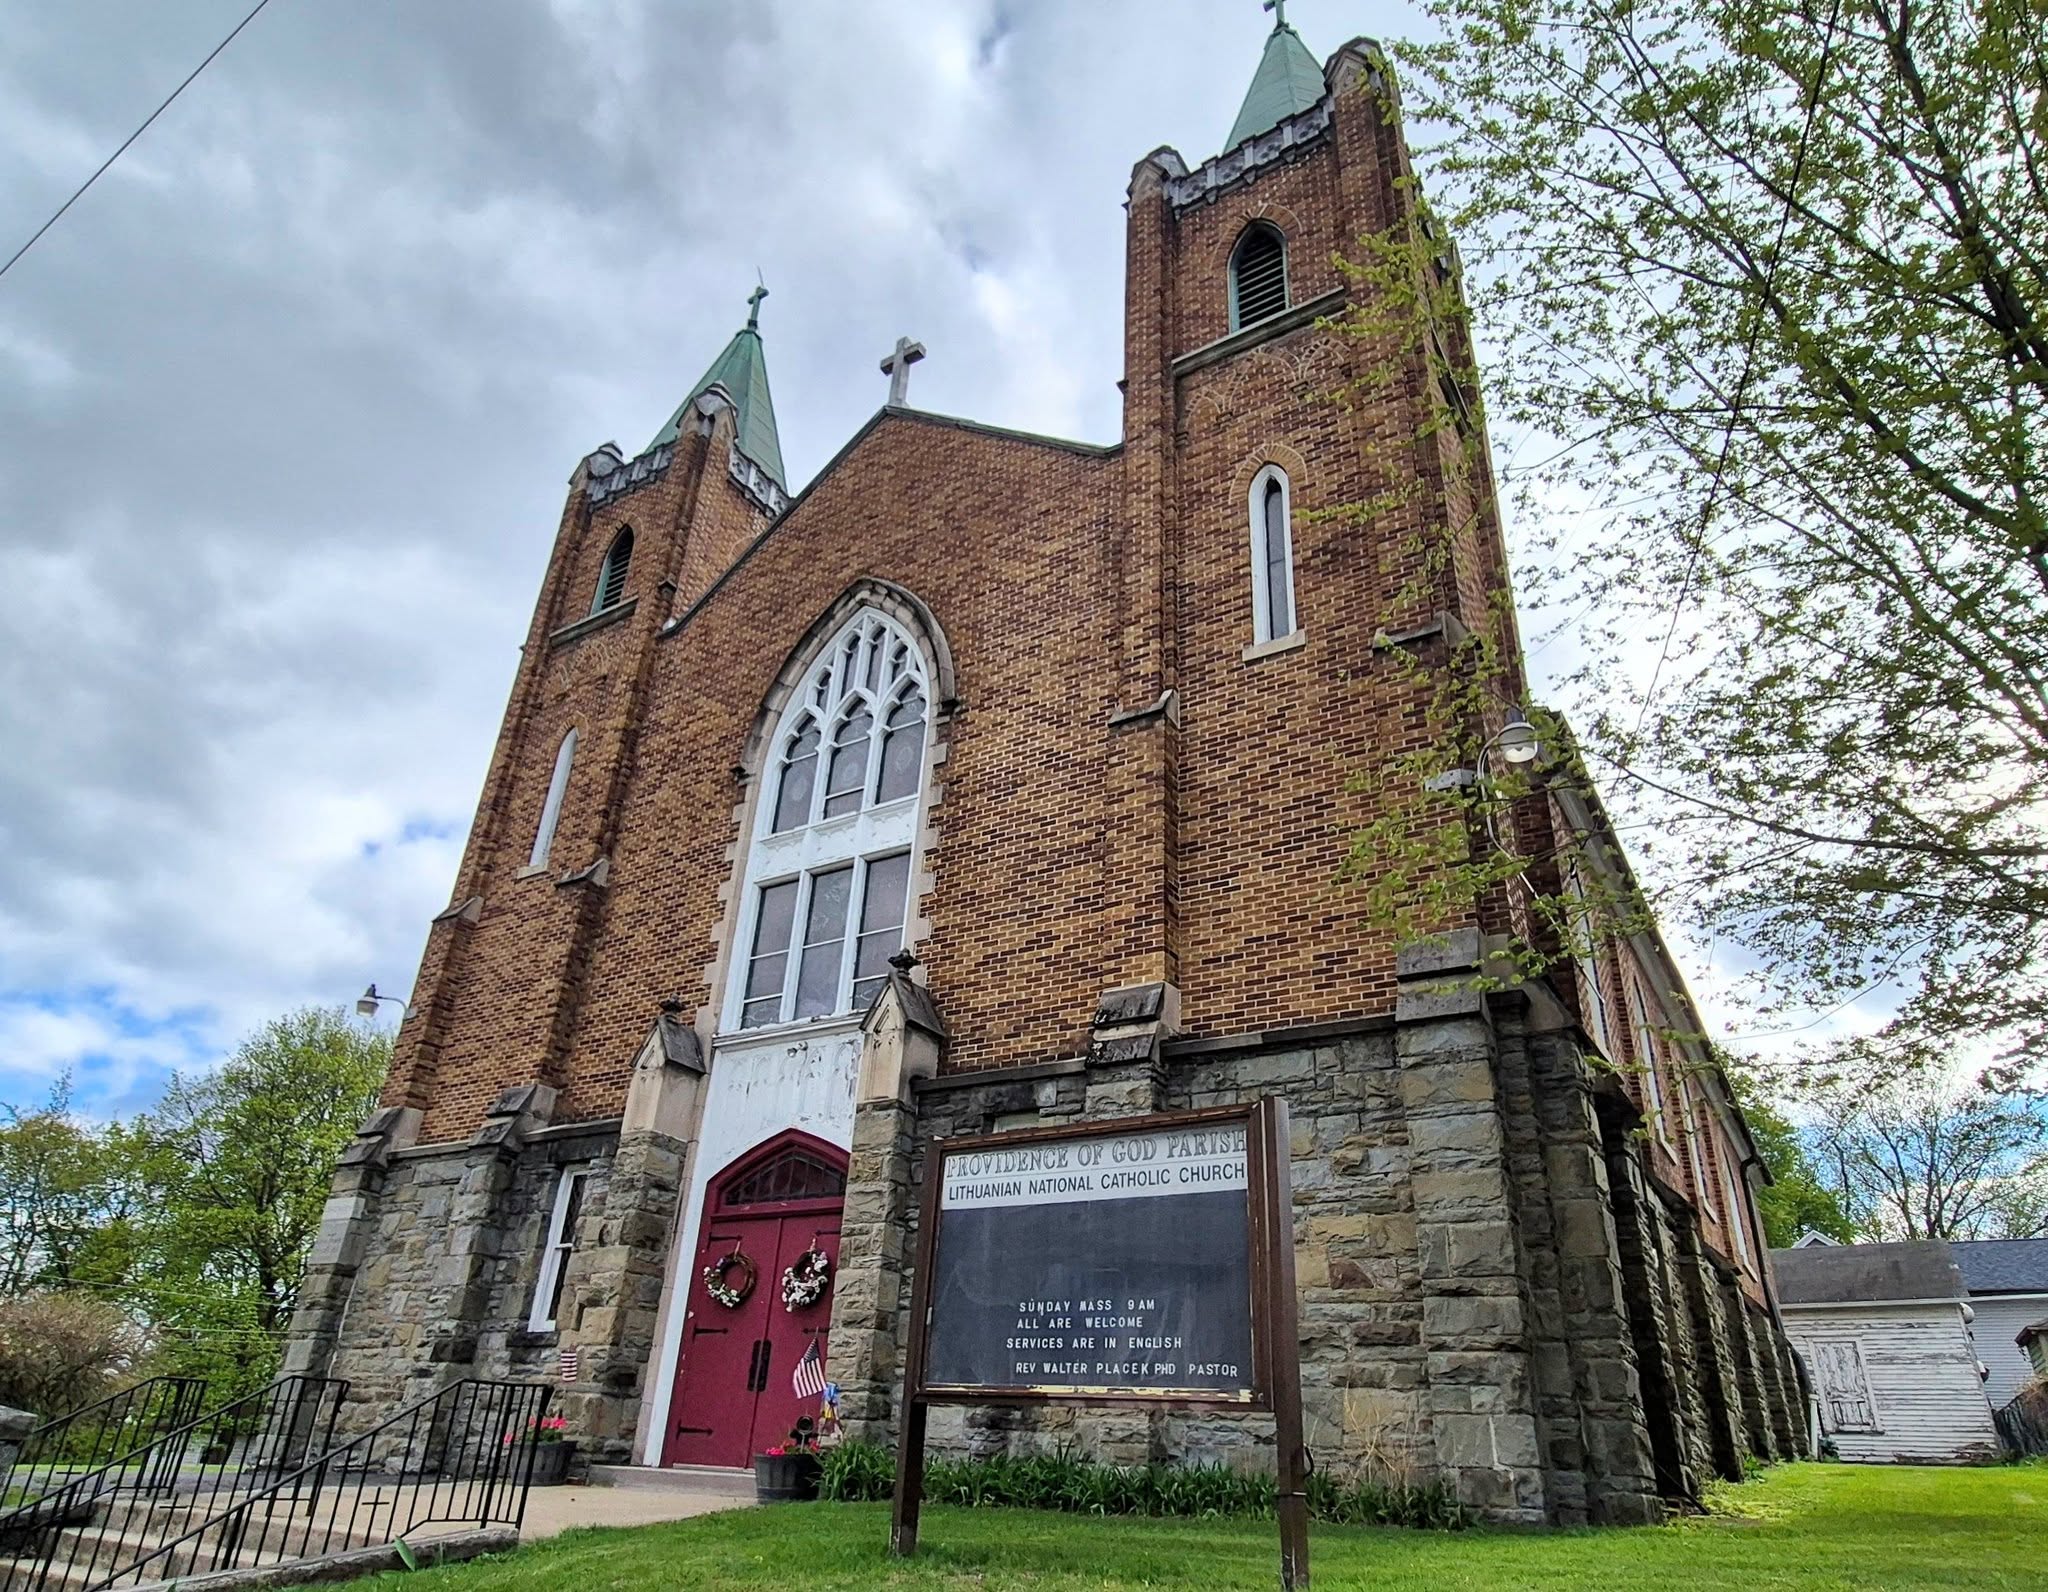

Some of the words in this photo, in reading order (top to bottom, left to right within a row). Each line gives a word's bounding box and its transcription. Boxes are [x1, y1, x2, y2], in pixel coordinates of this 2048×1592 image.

[946, 1147, 1069, 1178] PROVIDENCE
[1077, 1144, 1103, 1167] OF
[1112, 1138, 1157, 1163] GOD
[1166, 1129, 1247, 1159] PARISH
[949, 1180, 1022, 1201] LITHUANIAN
[1028, 1176, 1094, 1196] NATIONAL
[1100, 1169, 1171, 1190] CATHOLIC
[1178, 1162, 1246, 1184] CHURCH
[1019, 1300, 1071, 1316] SUNDAY
[1079, 1300, 1112, 1312] MASS
[1017, 1318, 1039, 1330] ALL
[1048, 1317, 1072, 1329] ARE
[1085, 1317, 1143, 1329] WELCOME
[1006, 1337, 1063, 1350] SERVICES
[1072, 1337, 1095, 1349] ARE
[1104, 1337, 1116, 1349] IN
[1129, 1337, 1182, 1349] ENGLISH
[1016, 1362, 1036, 1374] REV
[1043, 1362, 1088, 1375] WALTER
[1096, 1362, 1149, 1375] PLACEK
[1155, 1363, 1176, 1375] PHD
[1188, 1363, 1239, 1378] PASTOR
